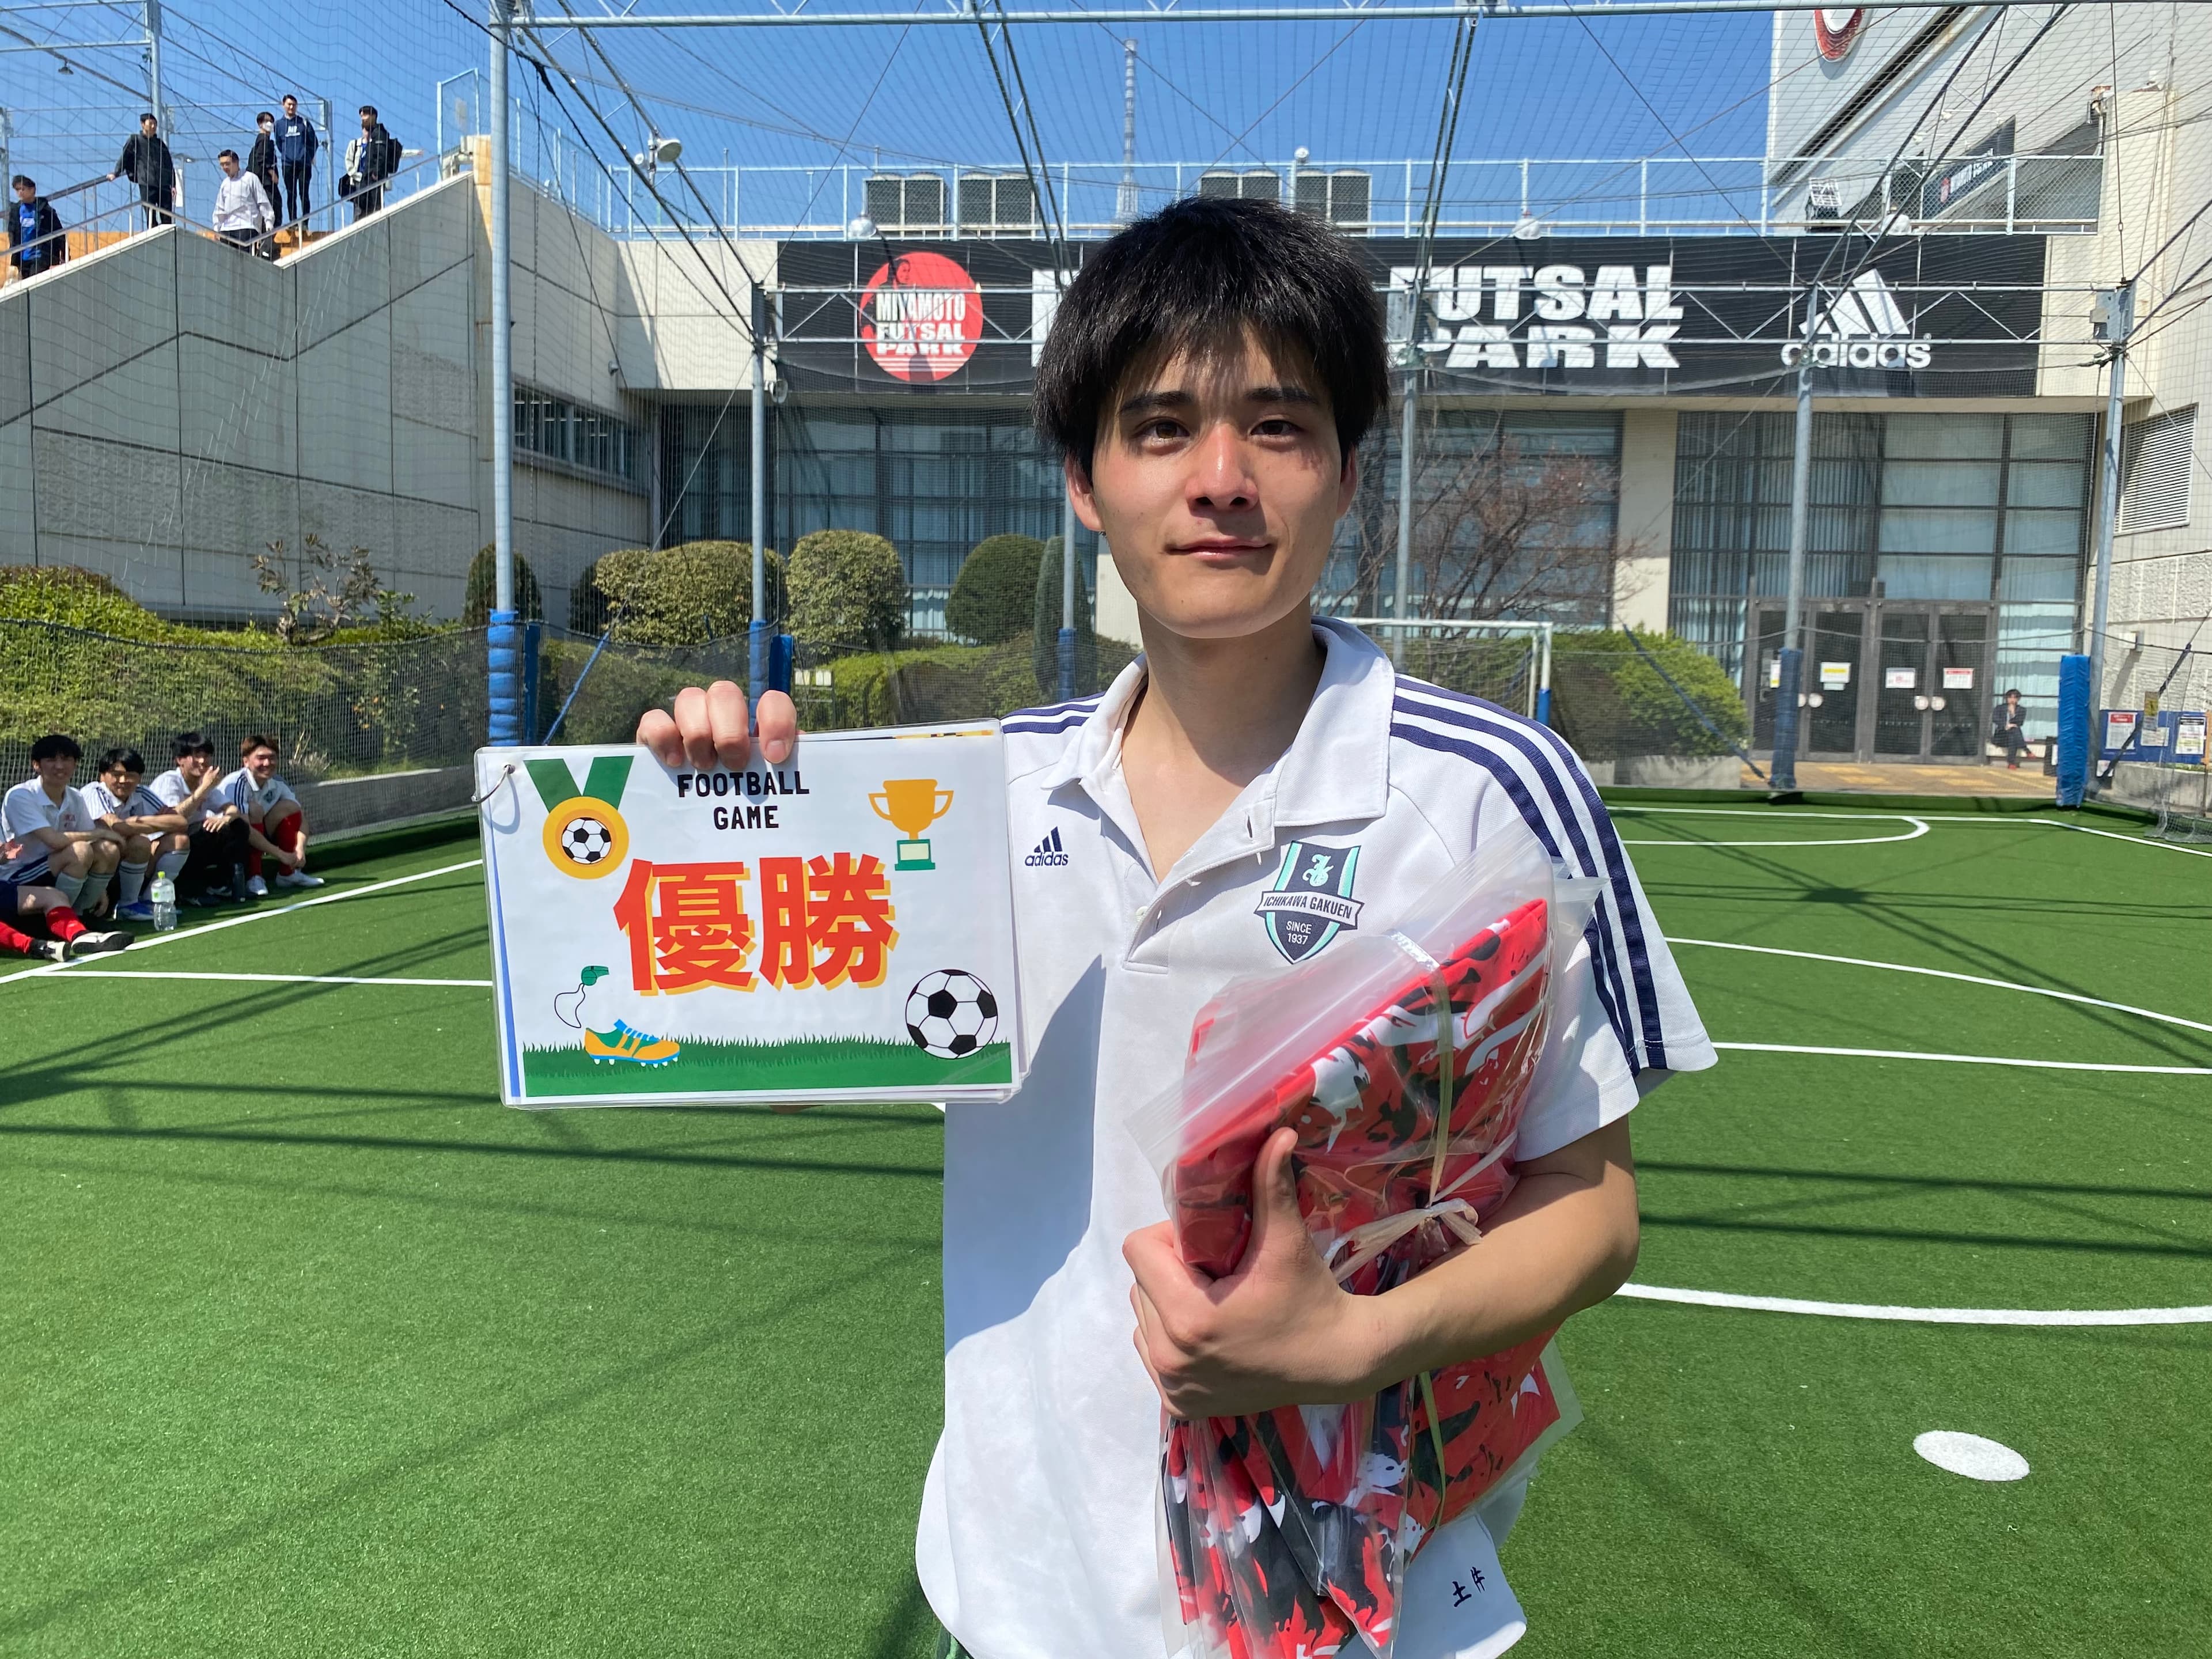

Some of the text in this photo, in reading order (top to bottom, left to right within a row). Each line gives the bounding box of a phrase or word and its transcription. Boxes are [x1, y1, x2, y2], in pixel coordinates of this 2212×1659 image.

[876, 291, 965, 321] MIYAMOTO
[876, 322, 965, 340] FUTSAL
[876, 340, 964, 355] PARK
[677, 771, 810, 798] FOOTBALL
[714, 805, 779, 830] GAME
[1025, 851, 1069, 866] adidas
[1263, 895, 1353, 919] ICHIKAWA GAKUEN
[613, 853, 899, 995] 優勝
[1286, 921, 1312, 934] SINCE
[1287, 933, 1308, 945] 1937
